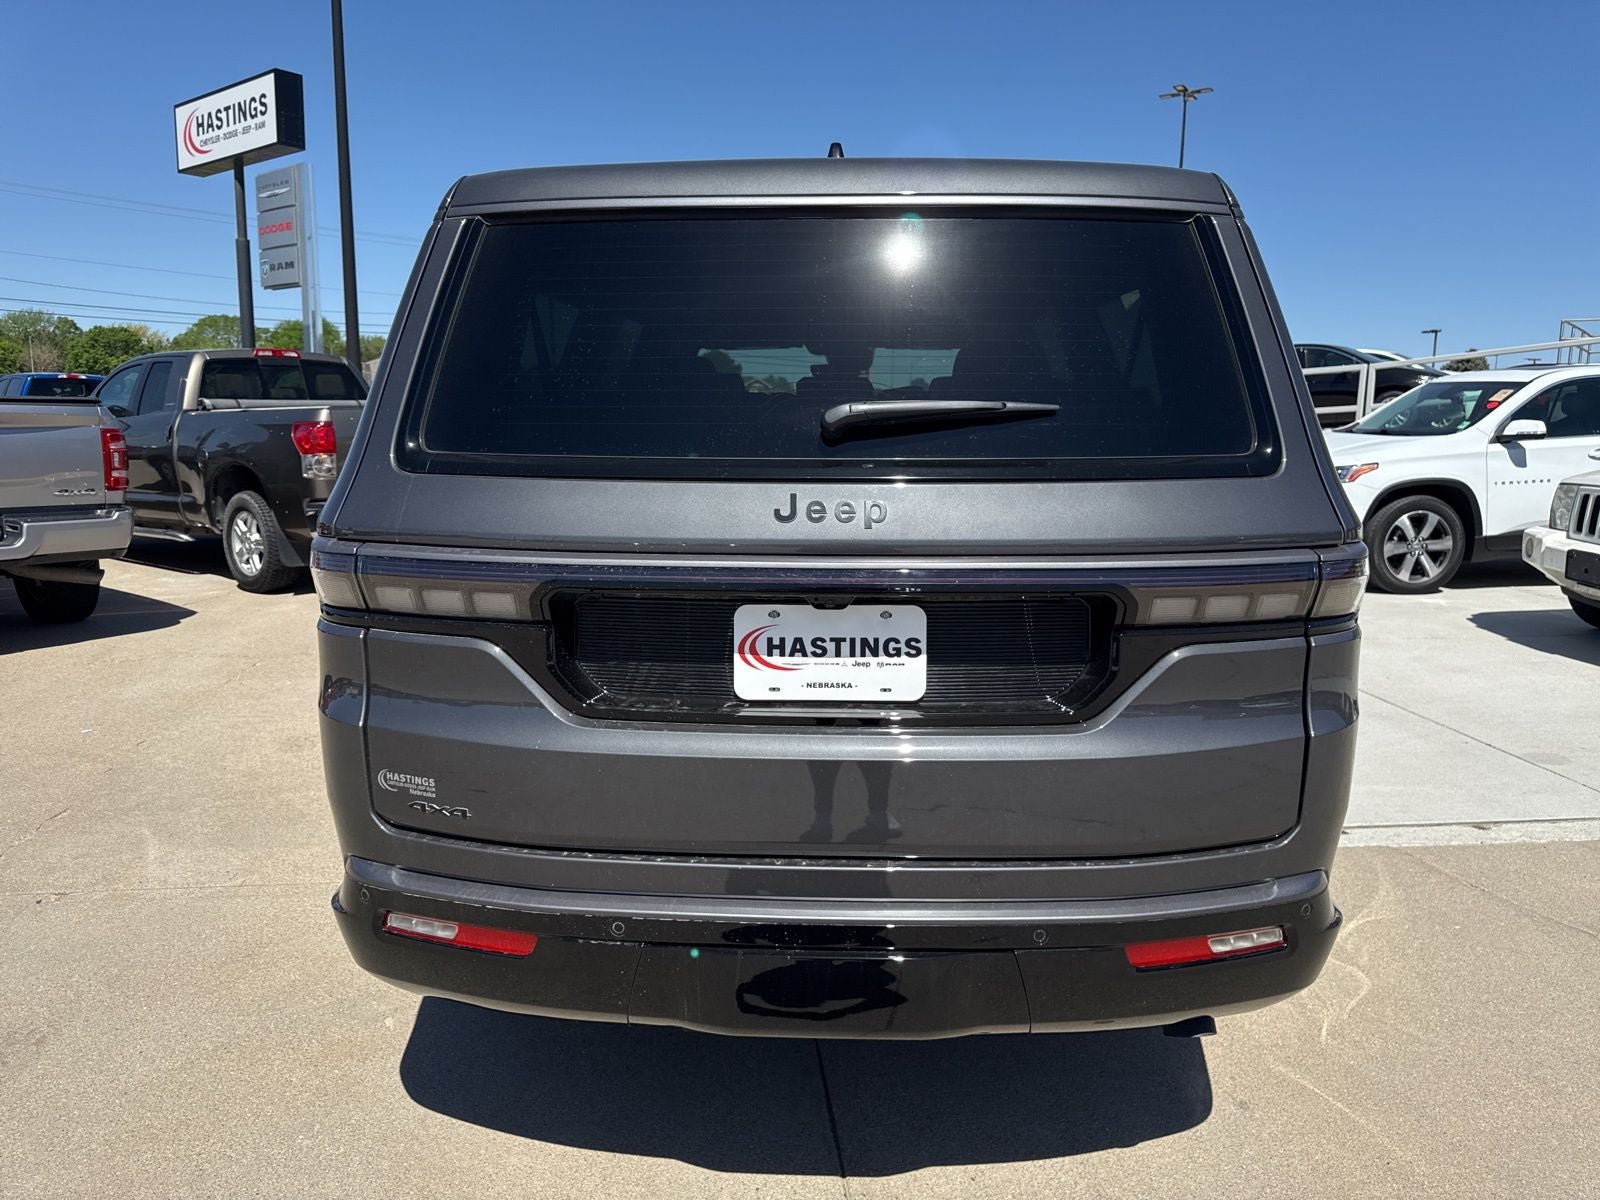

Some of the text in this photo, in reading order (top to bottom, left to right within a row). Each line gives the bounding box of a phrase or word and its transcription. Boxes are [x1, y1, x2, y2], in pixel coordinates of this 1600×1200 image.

[195, 93, 268, 137] HASTINGS
[259, 222, 292, 236] DODGE
[269, 261, 295, 272] RAM
[773, 492, 888, 530] Jeep
[766, 636, 922, 659] HASTINGS
[851, 660, 871, 669] Jeep
[386, 771, 436, 787] HASTINGS
